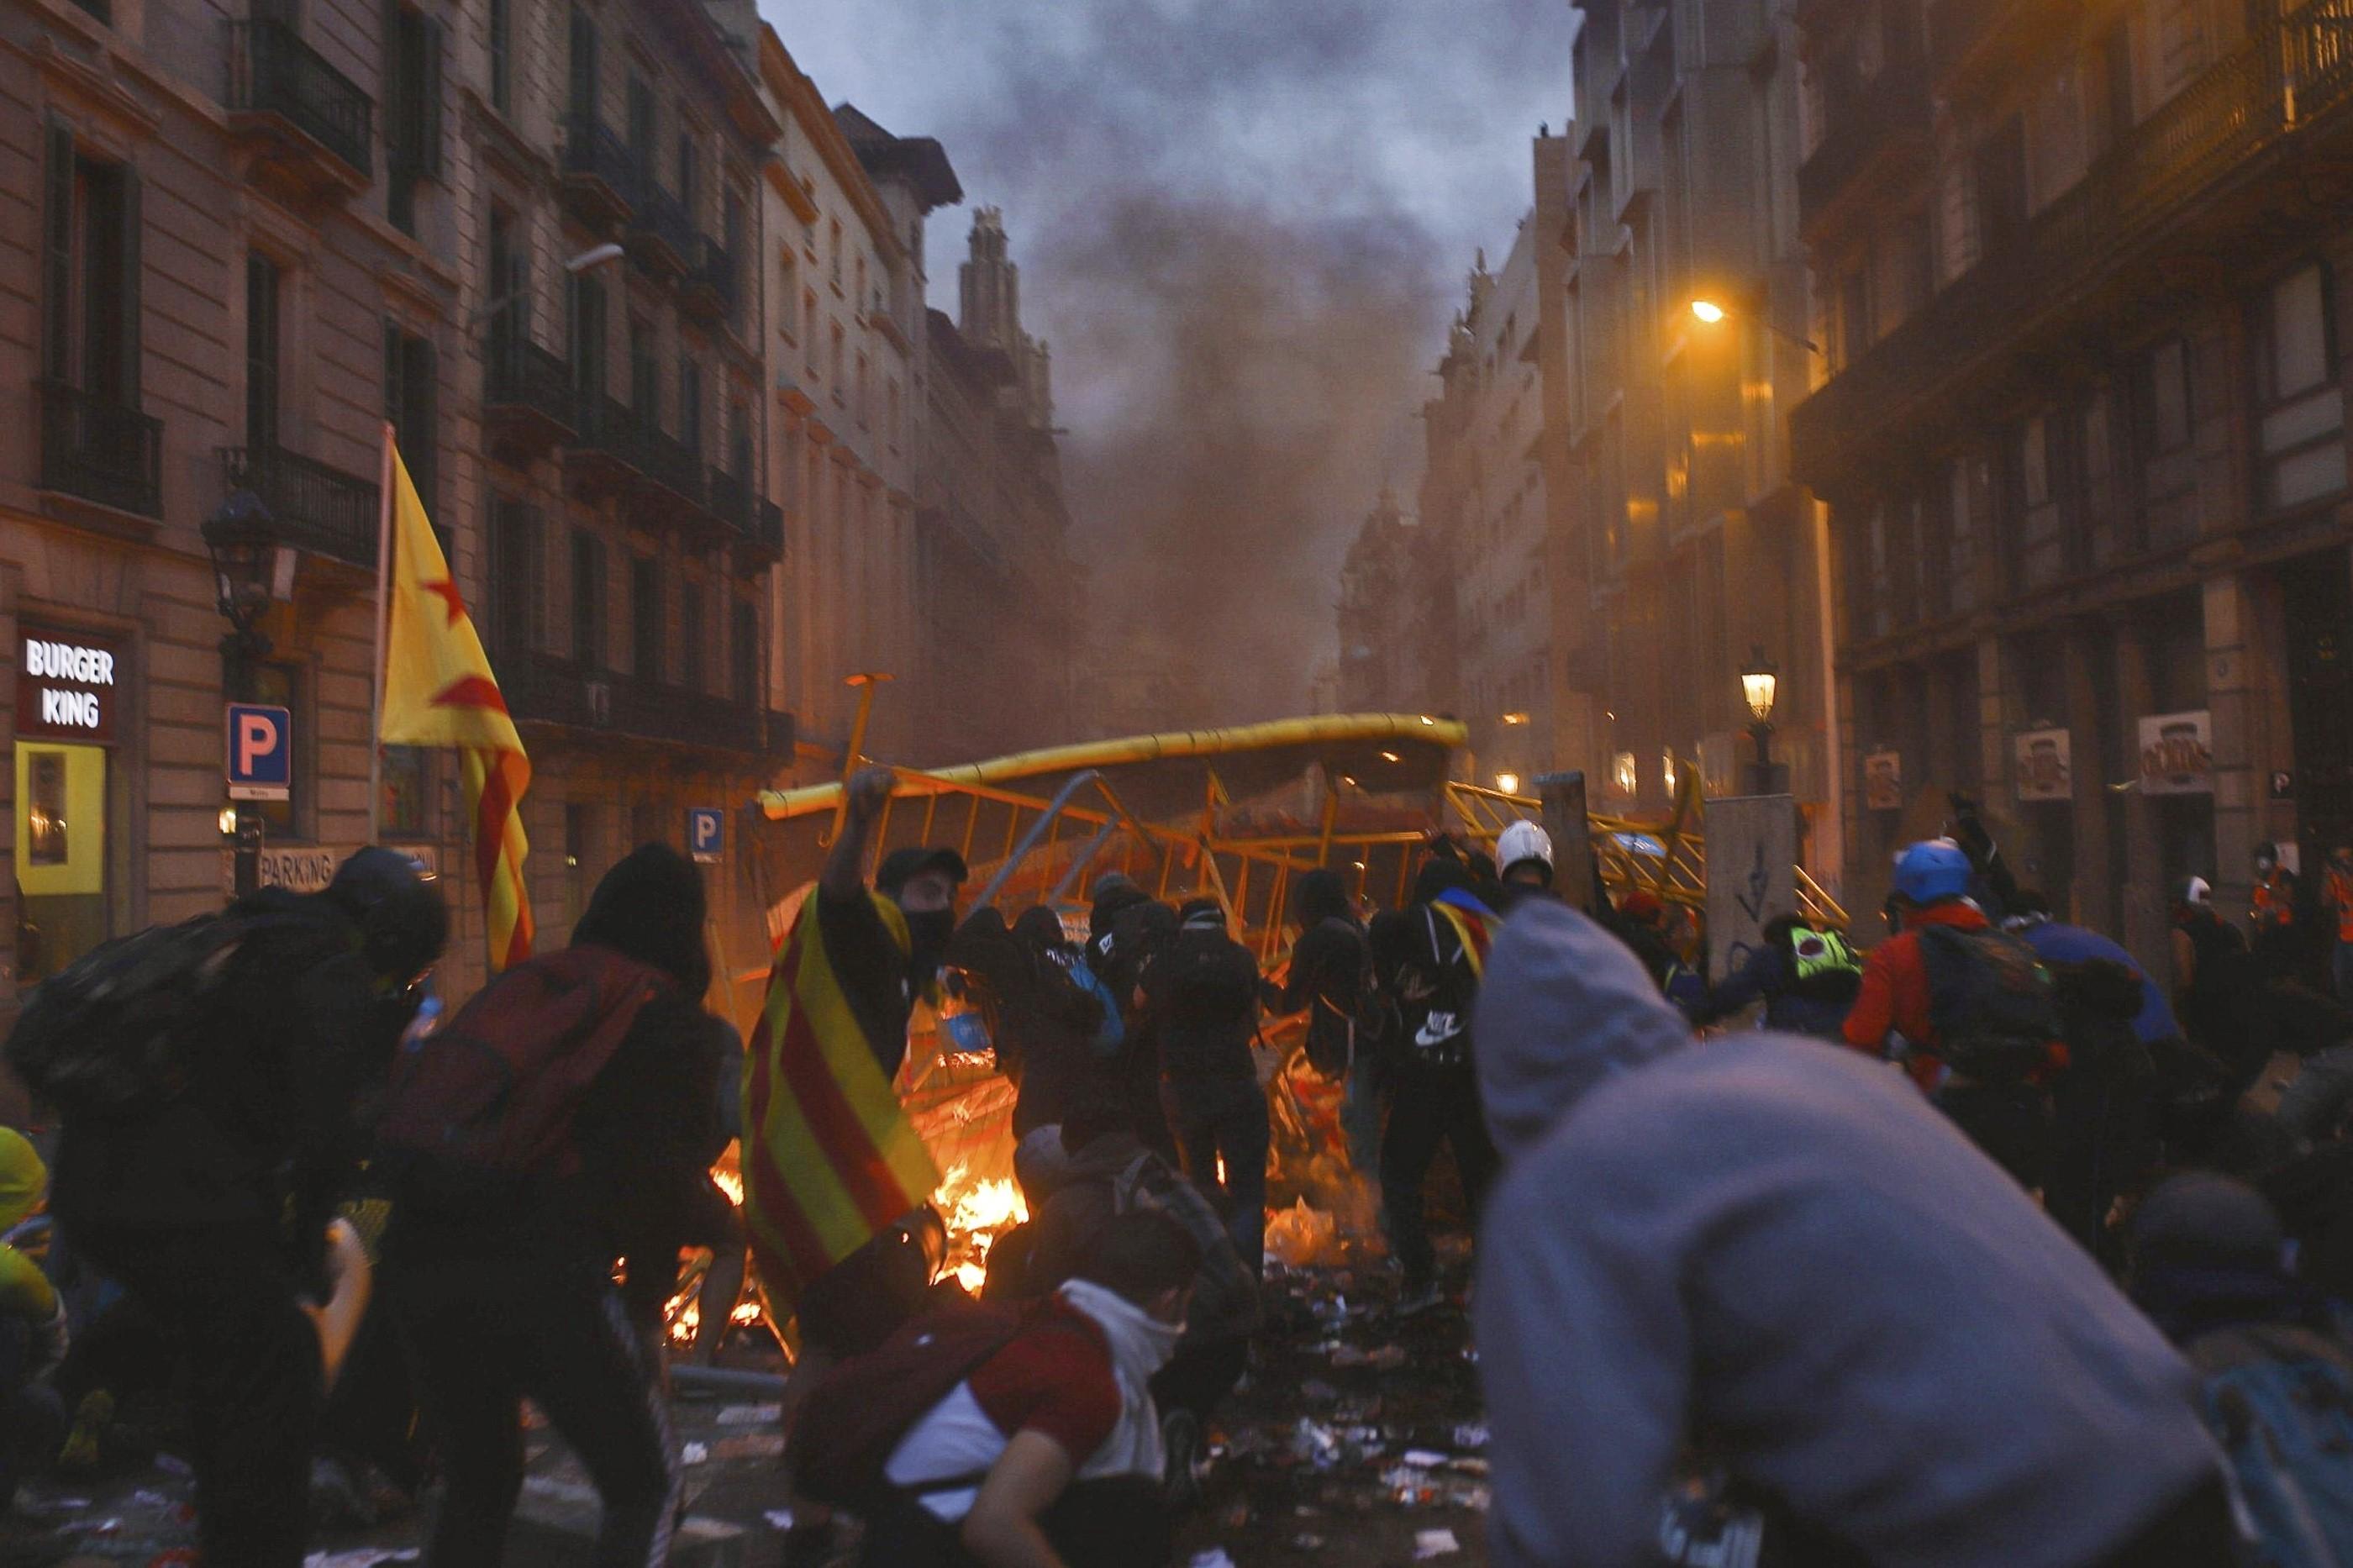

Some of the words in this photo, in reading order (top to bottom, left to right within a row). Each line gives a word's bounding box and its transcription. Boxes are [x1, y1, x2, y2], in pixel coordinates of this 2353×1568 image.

[26, 639, 113, 686] BURGER
[42, 687, 98, 729] KING
[240, 714, 277, 776] P
[697, 814, 717, 848] P
[261, 854, 330, 885] PARKING
